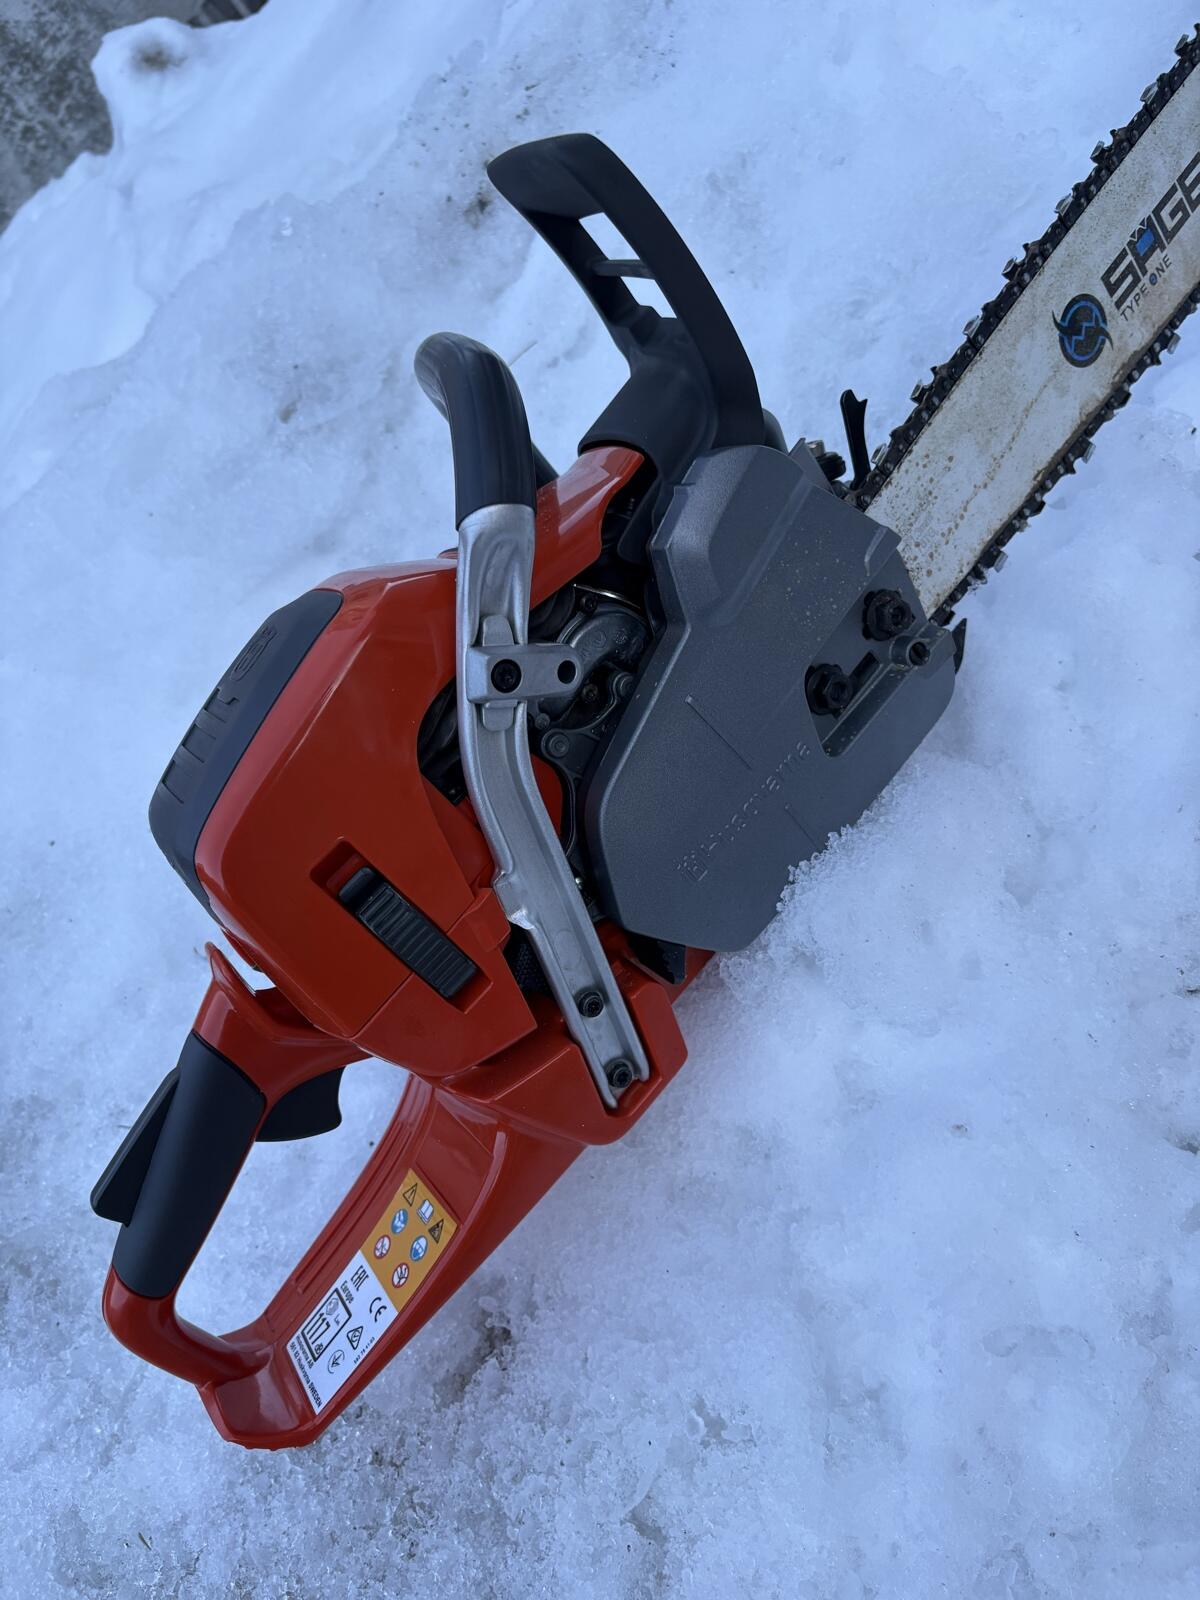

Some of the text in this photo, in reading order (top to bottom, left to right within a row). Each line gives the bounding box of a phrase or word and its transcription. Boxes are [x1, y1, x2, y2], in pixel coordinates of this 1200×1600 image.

[1120, 253, 1172, 322] TYPE ONE
[340, 1280, 354, 1304] Europe
[350, 1265, 369, 1292] EAC
[369, 1297, 387, 1323] CE
[306, 1313, 331, 1345] 117
